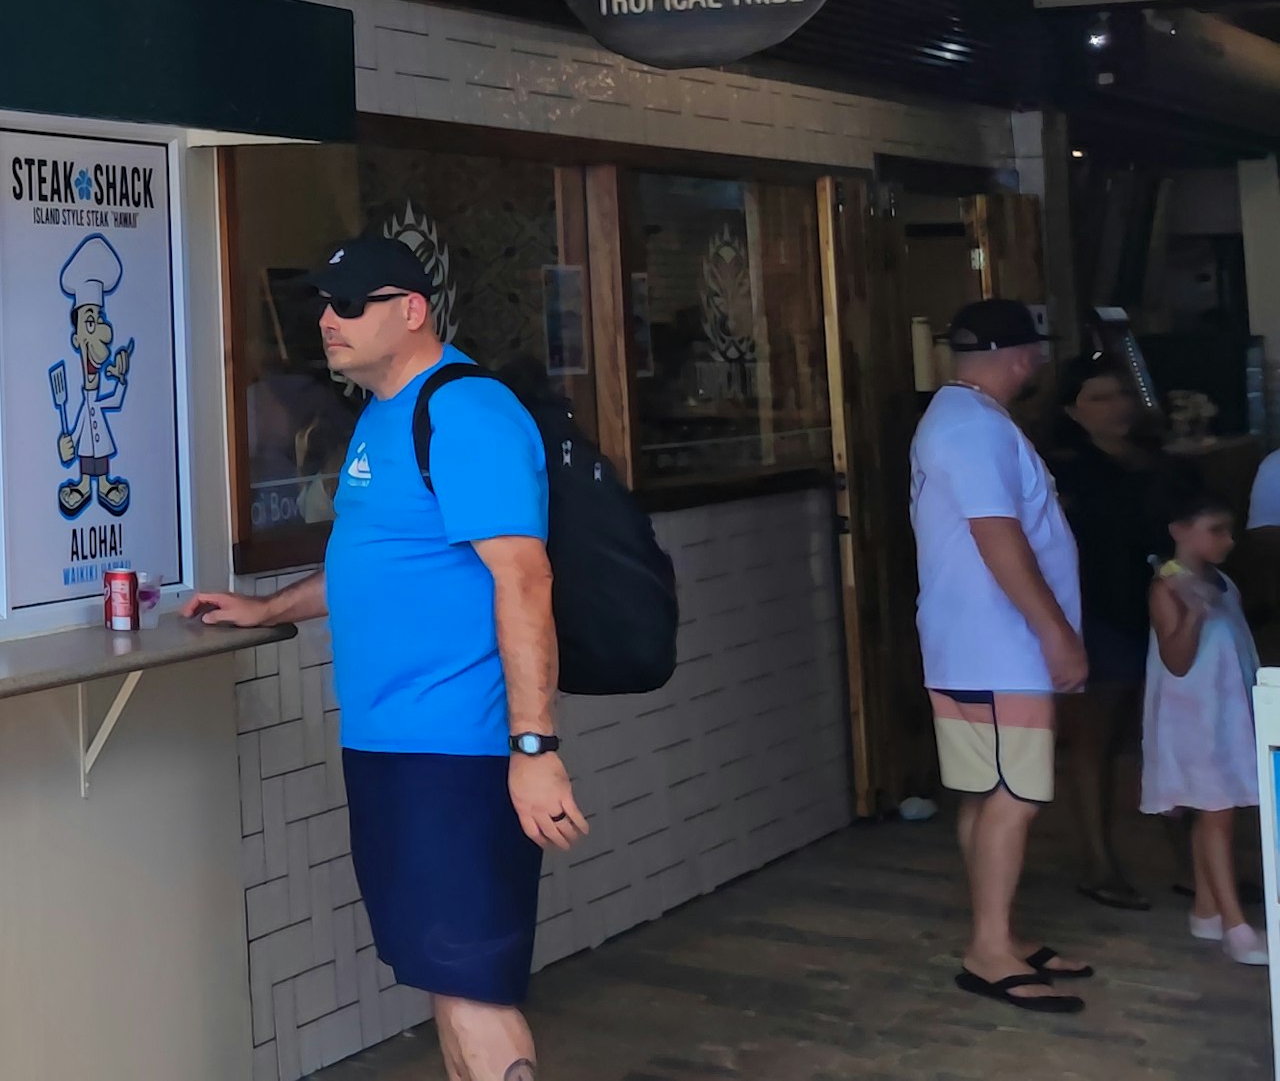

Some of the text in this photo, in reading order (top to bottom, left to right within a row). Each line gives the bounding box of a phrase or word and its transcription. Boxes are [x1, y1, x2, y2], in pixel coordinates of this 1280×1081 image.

[12, 157, 155, 209] STEAK SHACK
[33, 207, 60, 225] ISLAND
[62, 208, 84, 226] STYLE
[86, 210, 109, 228] STEAK
[70, 523, 123, 562] ALOHA!
[63, 564, 98, 586] WAIKIKI
